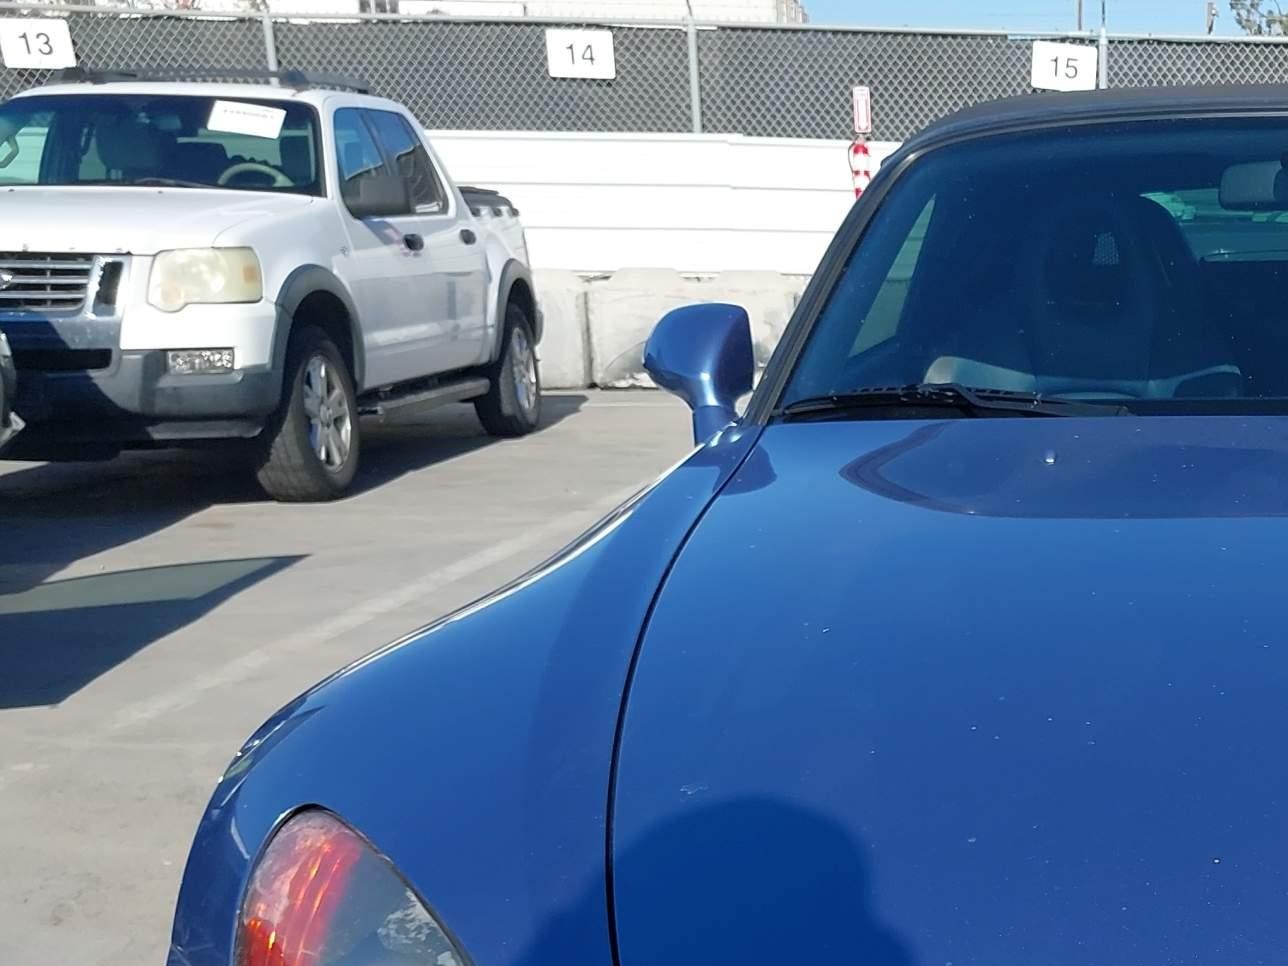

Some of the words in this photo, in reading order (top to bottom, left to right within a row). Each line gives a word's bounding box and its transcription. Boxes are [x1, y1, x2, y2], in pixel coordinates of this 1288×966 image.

[18, 31, 54, 56] 13
[565, 43, 595, 66] 14
[1050, 55, 1079, 79] 15
